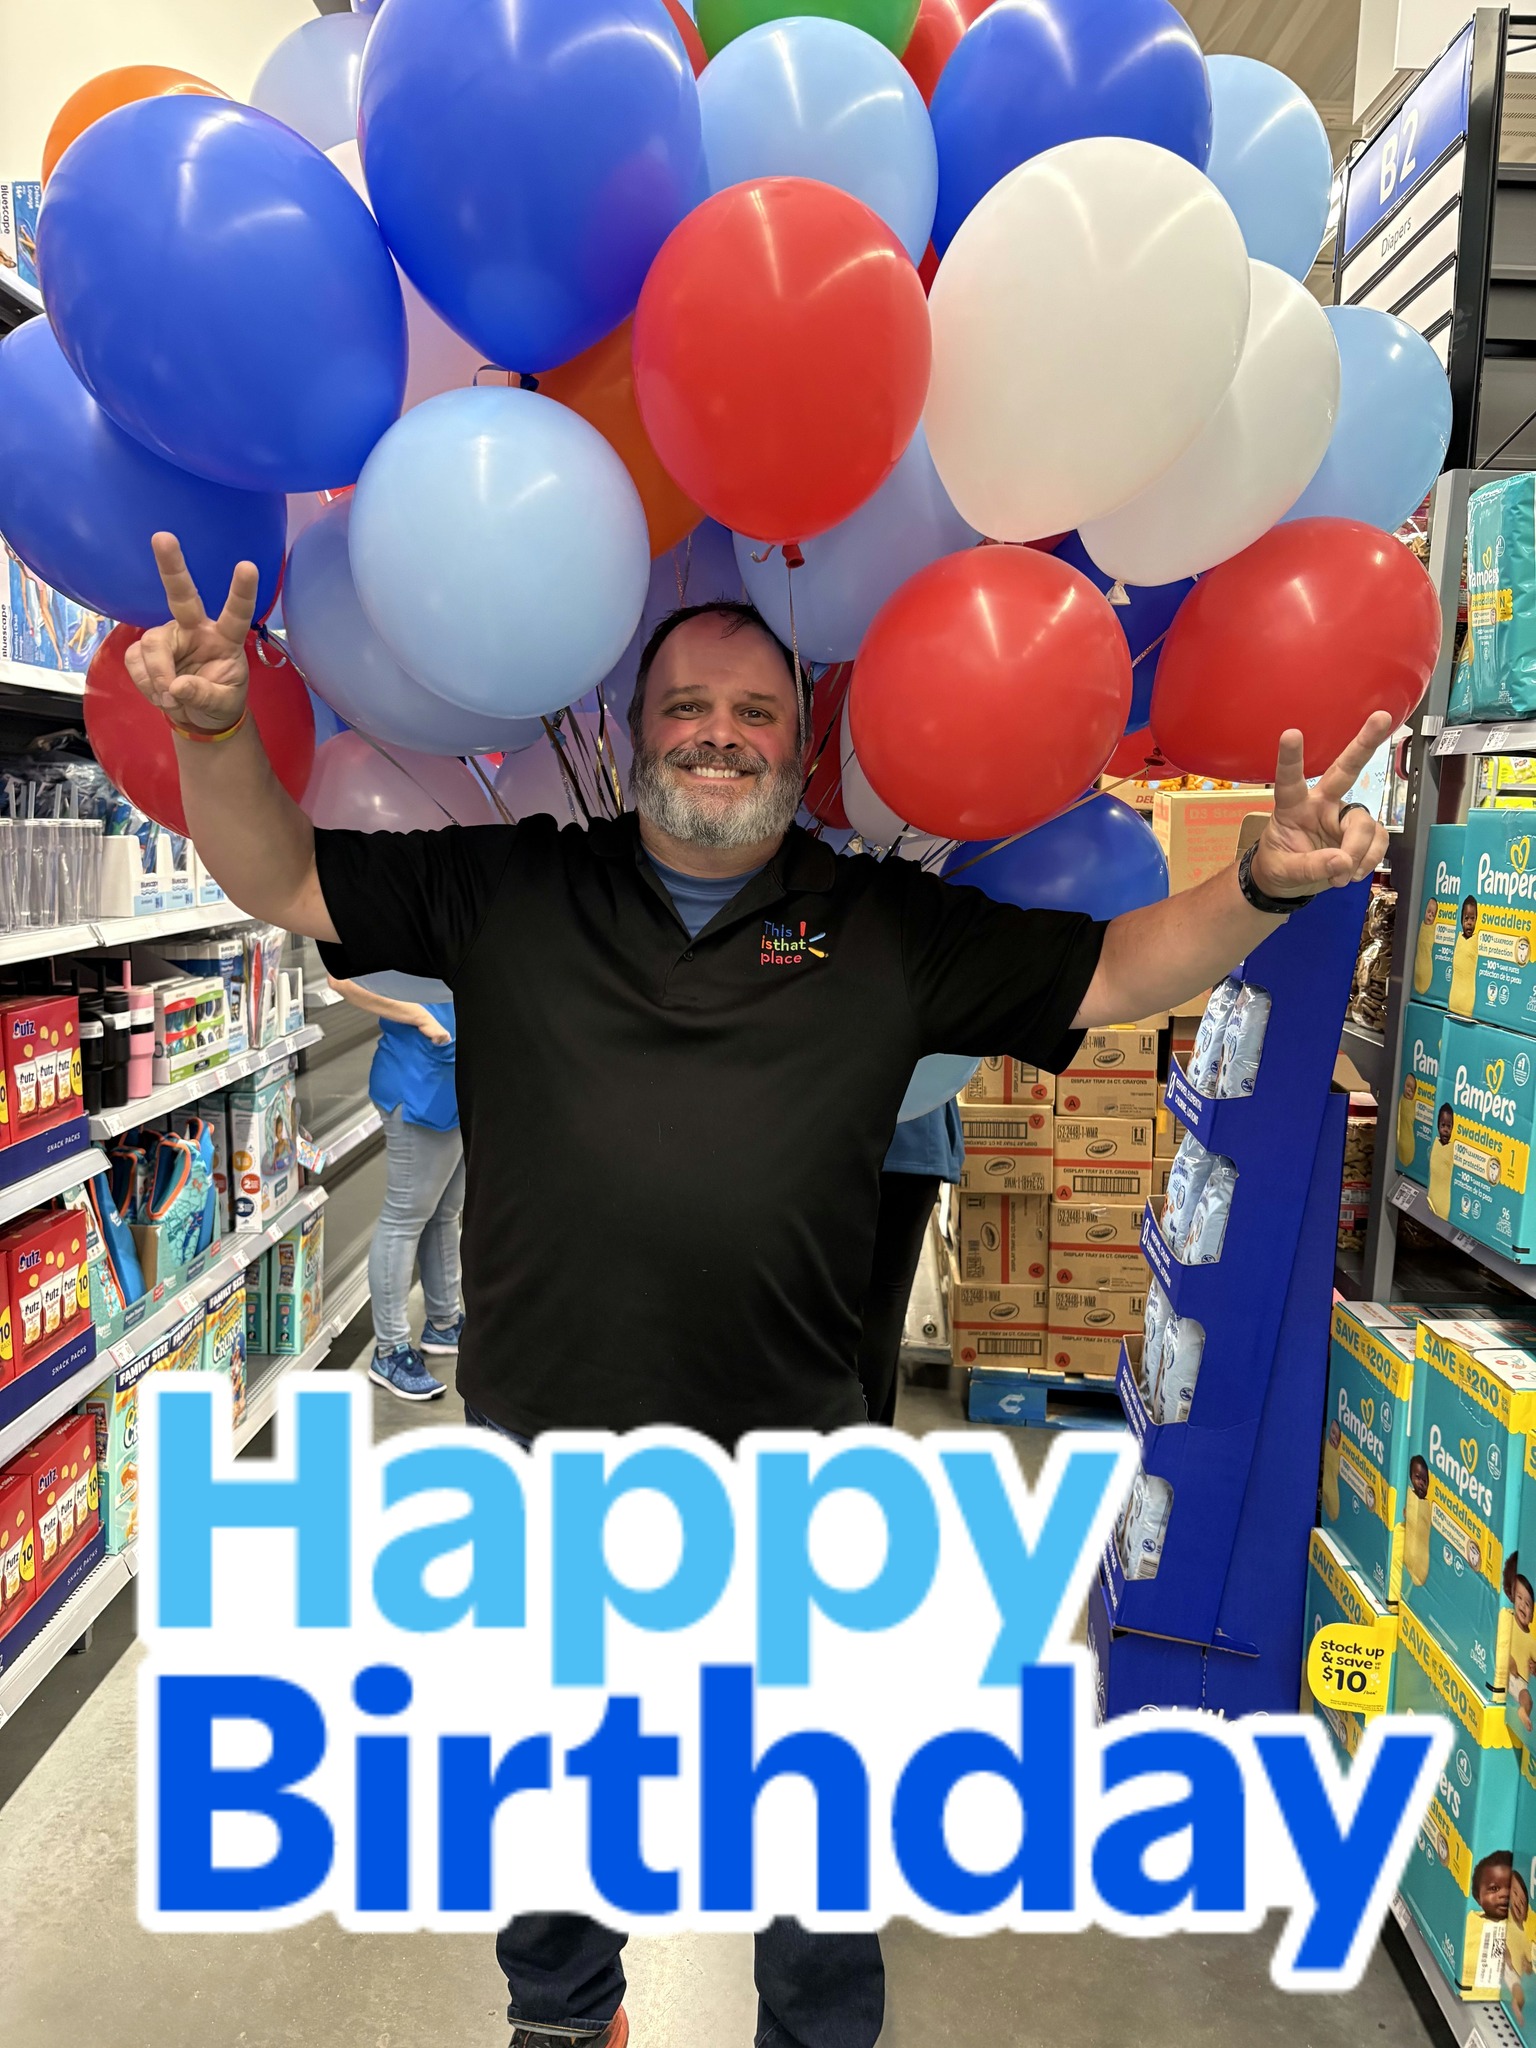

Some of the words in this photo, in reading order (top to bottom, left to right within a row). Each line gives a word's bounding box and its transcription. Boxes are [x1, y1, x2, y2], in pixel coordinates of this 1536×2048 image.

[1380, 108, 1418, 205] B2
[1381, 216, 1412, 257] Diapers
[764, 920, 792, 938] This
[1482, 912, 1532, 932] swaddlers
[760, 950, 802, 966] place
[1478, 944, 1488, 953] skin
[1488, 946, 1513, 957] protection
[72, 1061, 80, 1078] 10
[1068, 1099, 1076, 1108] A
[1454, 1065, 1516, 1127] Pampers
[47, 1139, 64, 1153] SNACK
[65, 1132, 80, 1144] PACKS
[1456, 1124, 1502, 1153] swaddlers
[1463, 1158, 1486, 1173] protection
[1510, 1150, 1516, 1167] 1
[244, 1178, 251, 1189] 2
[1060, 1188, 1068, 1197] A
[238, 1202, 244, 1212] 3
[1502, 1207, 1510, 1220] 96
[78, 1274, 88, 1293] 10
[1061, 1272, 1068, 1280] A
[209, 1284, 232, 1309] FAMILY
[232, 1274, 245, 1290] SIZE
[172, 1321, 193, 1346] FAMILY
[194, 1307, 205, 1326] SIZE
[1336, 1317, 1360, 1352] SAVE
[51, 1359, 69, 1376] SNACK
[70, 1346, 87, 1362] PACKS
[120, 1355, 151, 1386] FAMILY
[152, 1341, 169, 1363] SIZE
[1059, 1356, 1066, 1364] A
[1423, 1334, 1456, 1374] SAVE
[1338, 1388, 1384, 1465] Pampers
[1342, 1440, 1377, 1483] swaddlers
[1430, 1424, 1493, 1517] Pampers
[89, 1477, 97, 1497] 10
[1435, 1486, 1482, 1539] swaddlers
[22, 1544, 33, 1566] 10
[1488, 1541, 1492, 1559] 1
[67, 1566, 82, 1585] SNACK
[83, 1548, 98, 1567] PACKS
[1313, 1543, 1334, 1583] SAVE
[1320, 1640, 1362, 1655] stock
[1366, 1648, 1384, 1659] up
[1402, 1616, 1430, 1666] SAVE
[1475, 1640, 1486, 1660] 160
[1322, 1652, 1333, 1663] &
[1336, 1657, 1373, 1669] save
[1322, 1665, 1367, 1692] $10
[1456, 1843, 1460, 1860] 1
